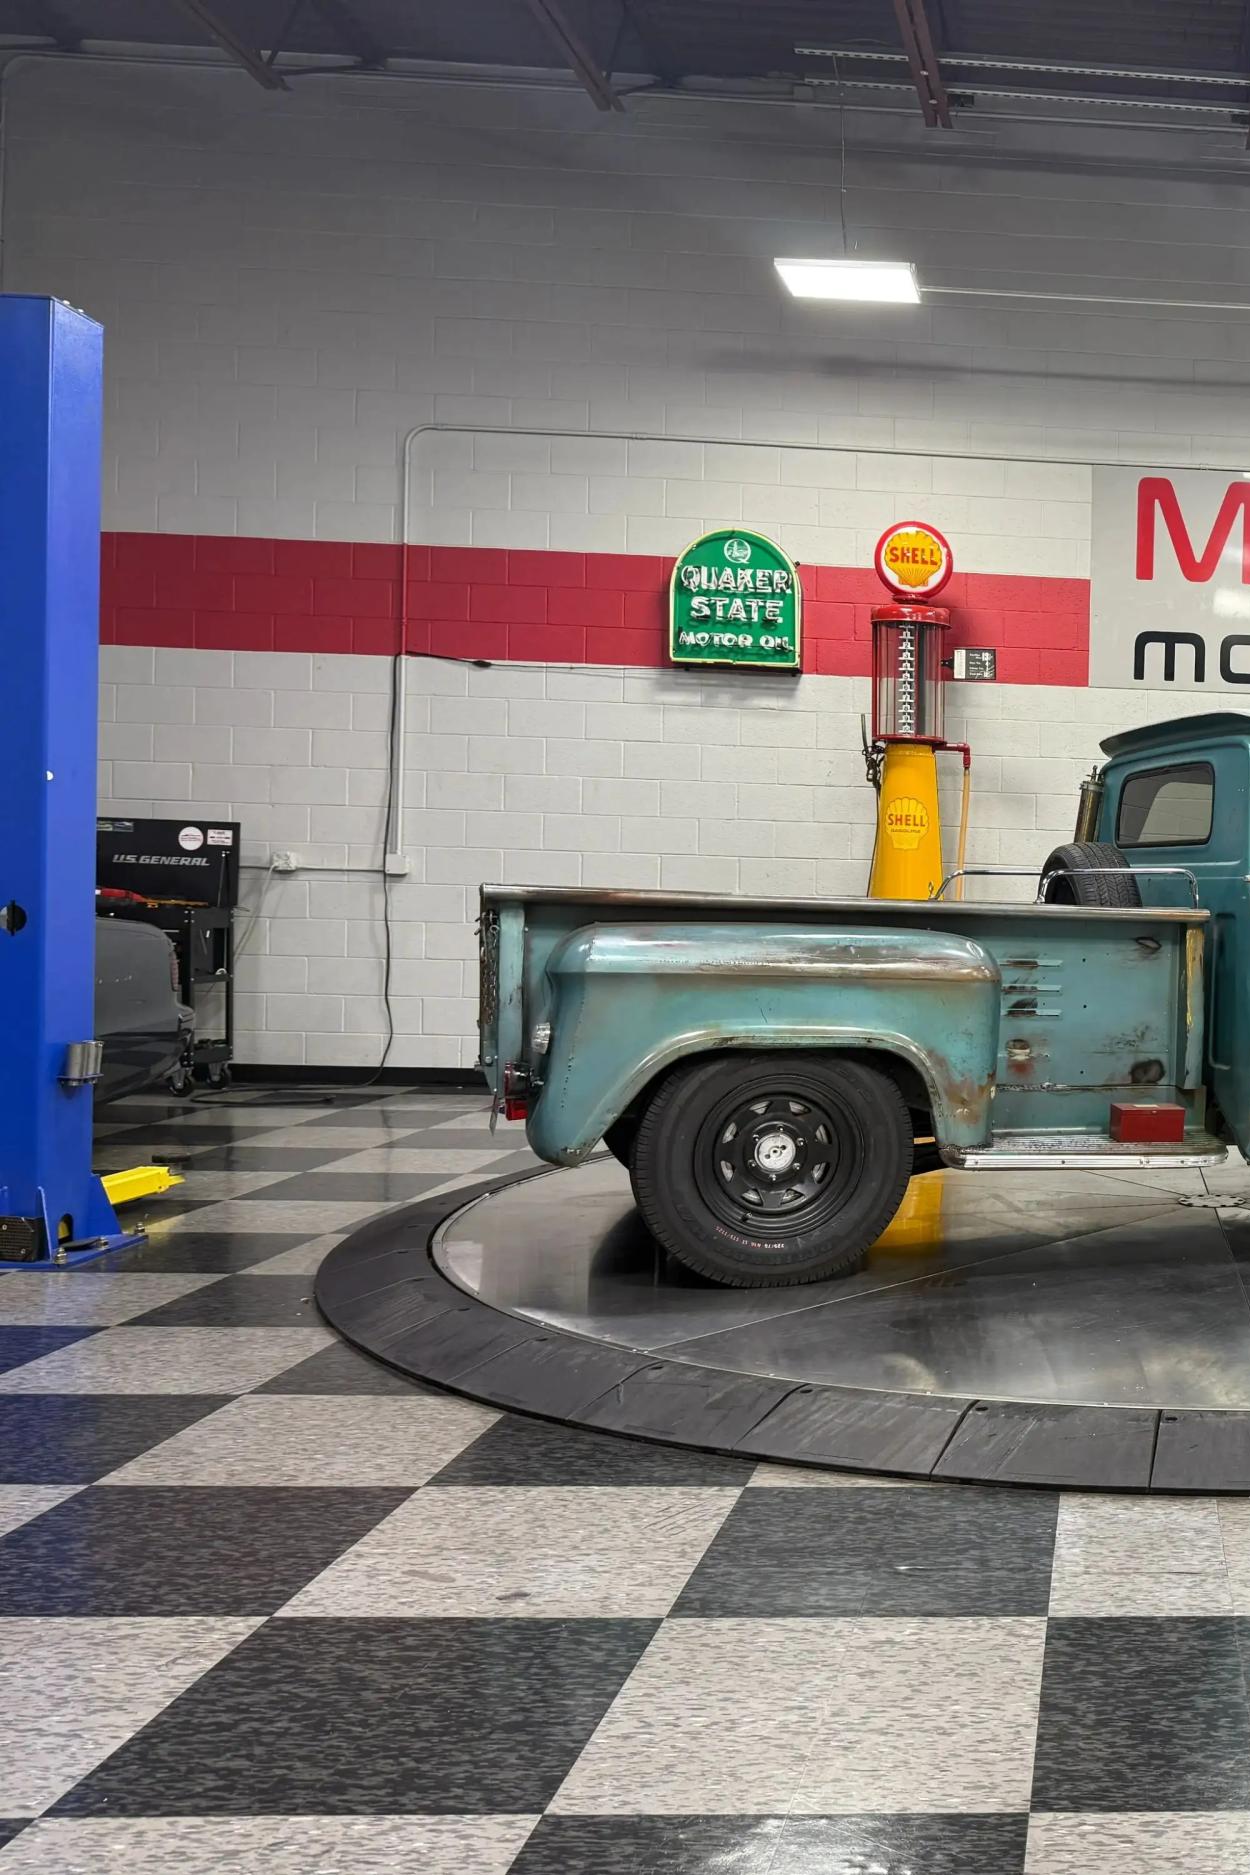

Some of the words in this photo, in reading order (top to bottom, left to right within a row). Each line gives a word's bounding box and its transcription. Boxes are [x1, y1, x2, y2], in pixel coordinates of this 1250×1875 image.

[889, 546, 938, 566] SHELL
[681, 565, 793, 594] QUAKER
[690, 596, 784, 623] STATE
[679, 631, 753, 648] MOTOR
[759, 635, 794, 651] OIL
[888, 813, 925, 827] SHELL
[139, 855, 210, 866] GENERAL
